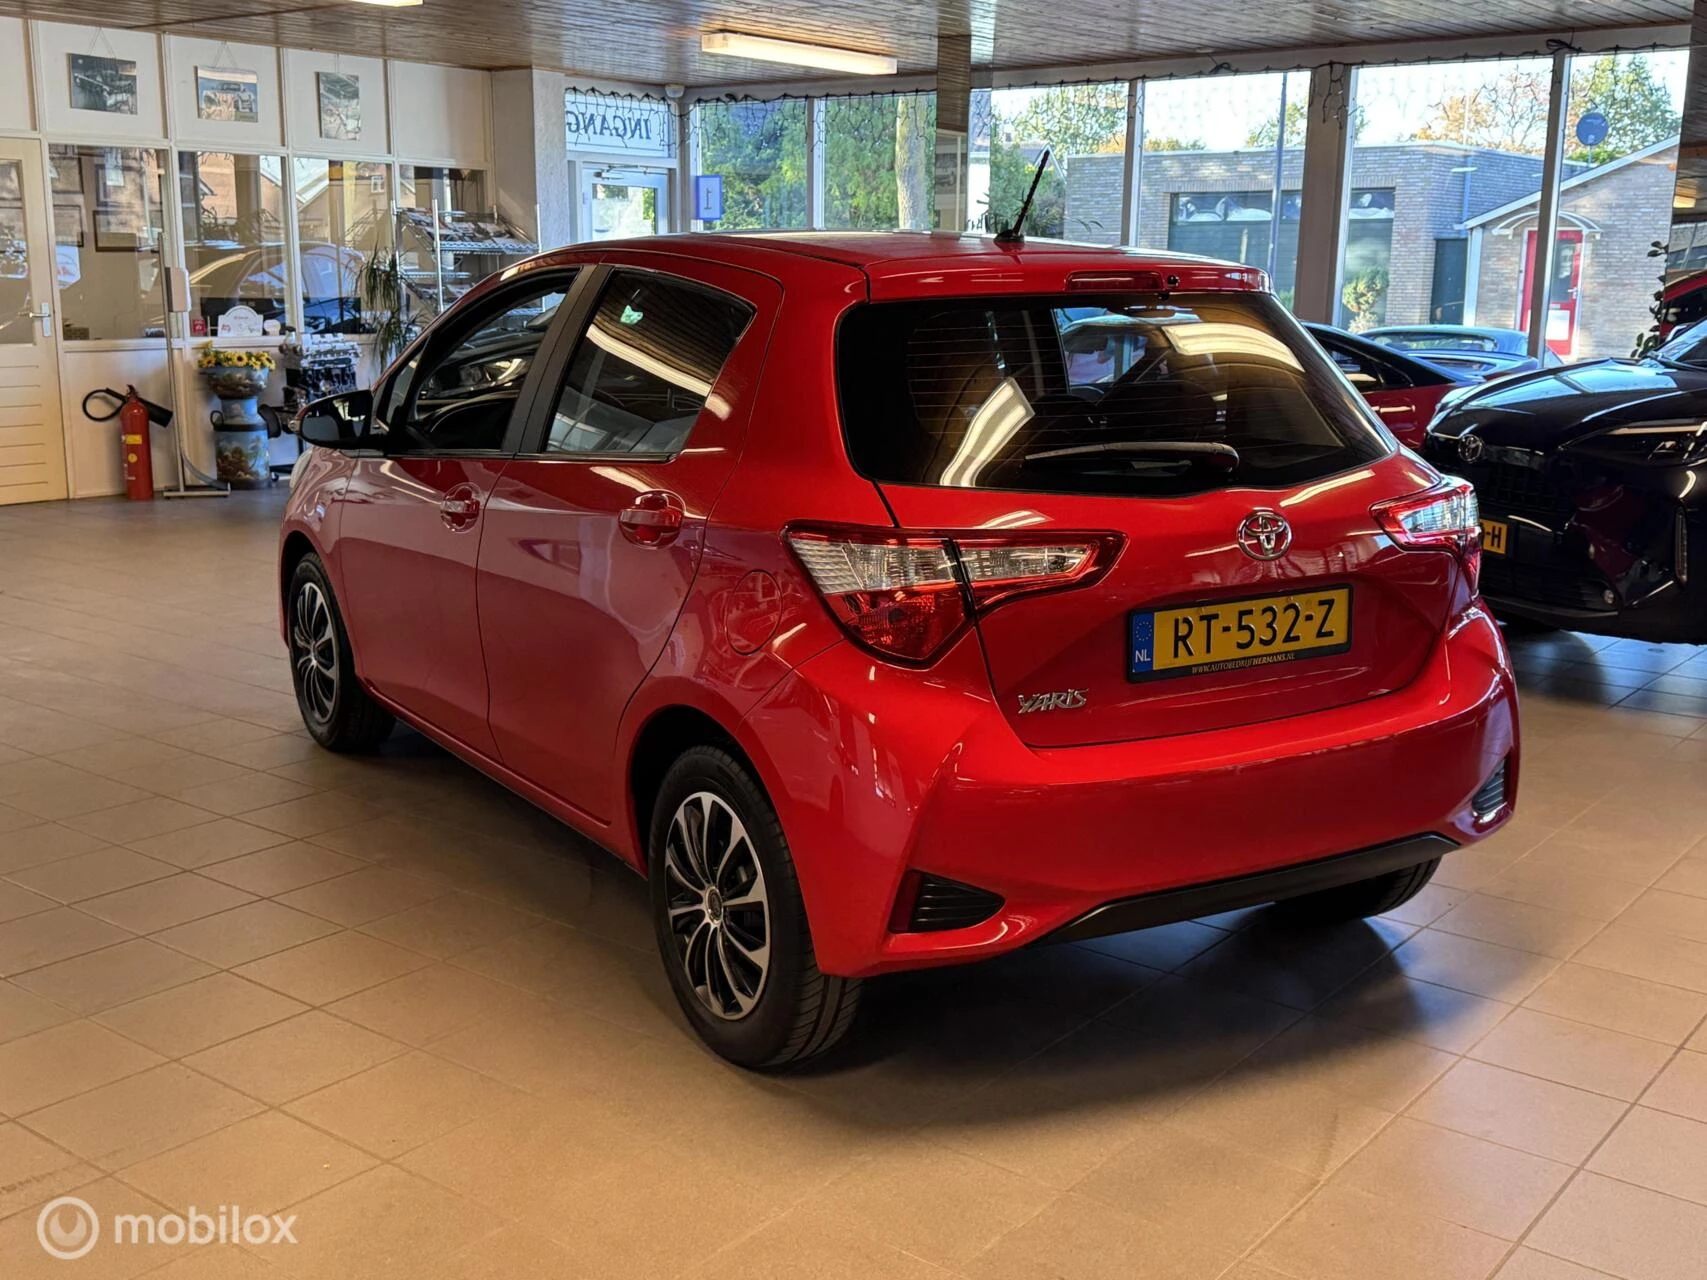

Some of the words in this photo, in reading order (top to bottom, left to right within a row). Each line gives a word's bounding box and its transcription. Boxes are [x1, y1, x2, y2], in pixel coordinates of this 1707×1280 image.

[1173, 598, 1336, 659] RT-532-Z
[1135, 649, 1152, 663] NL
[1017, 688, 1090, 714] YARIS
